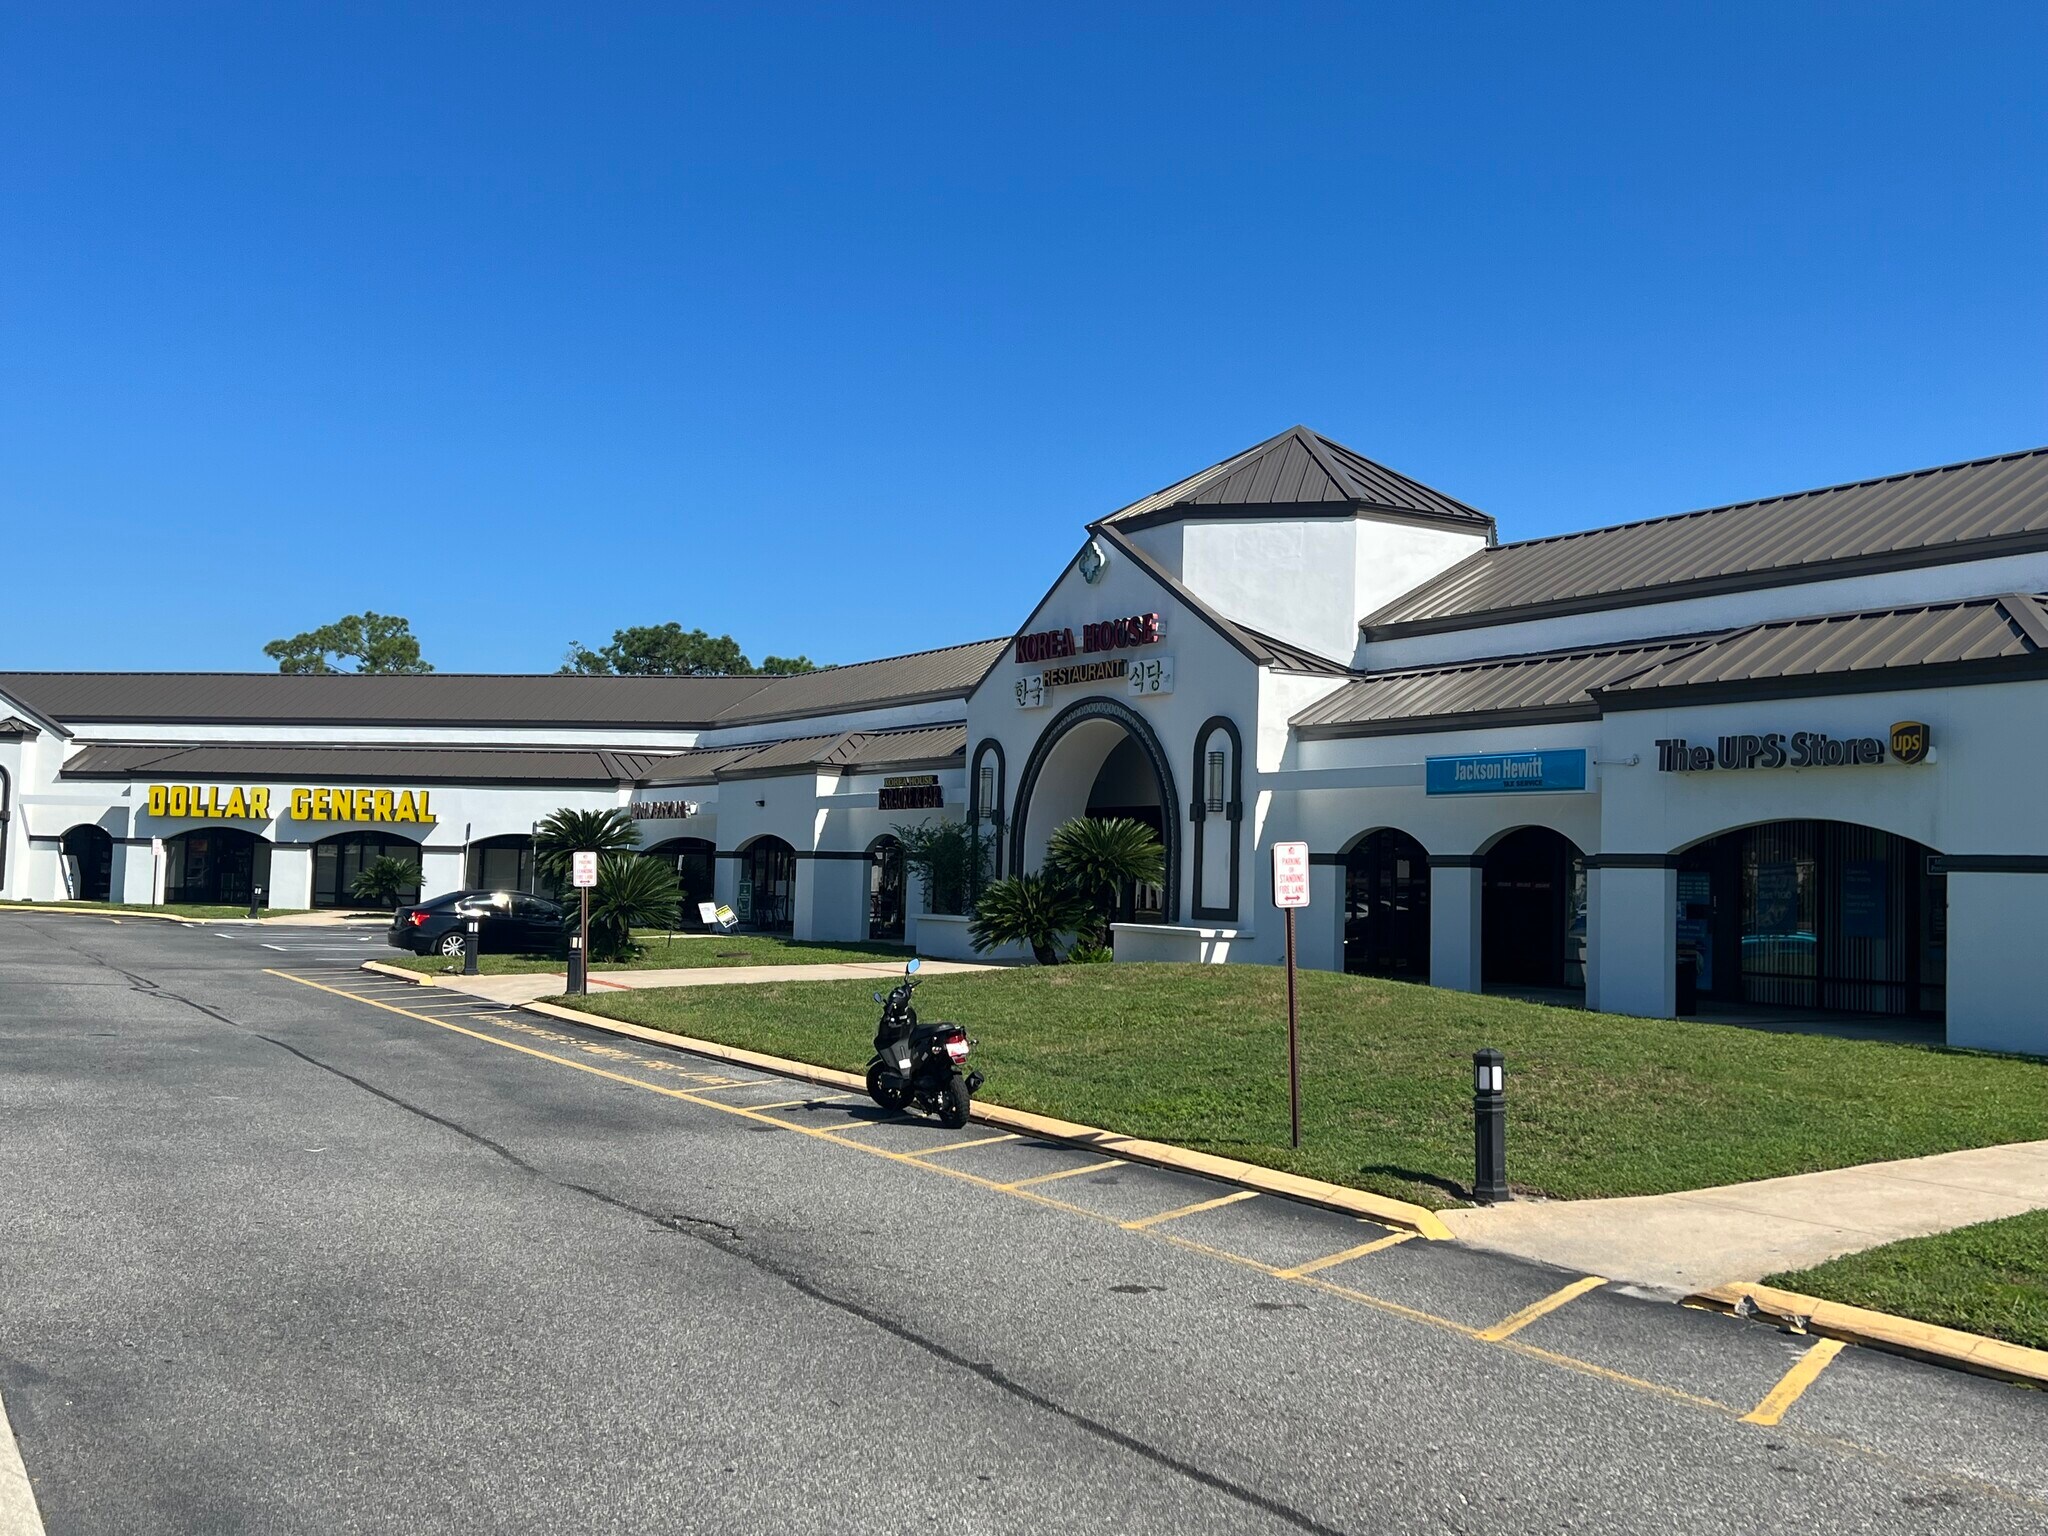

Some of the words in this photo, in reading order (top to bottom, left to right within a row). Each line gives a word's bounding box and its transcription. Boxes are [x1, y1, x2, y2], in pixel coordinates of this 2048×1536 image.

[1015, 628, 1076, 663] KOREA
[1083, 613, 1160, 653] HOUSE
[1043, 660, 1124, 687] RESTAURANT
[1129, 660, 1163, 693] 식당
[1015, 677, 1043, 707] 한국
[1655, 739, 1714, 772] The
[1717, 733, 1786, 770] UPS
[1790, 732, 1884, 767] Store
[1893, 734, 1920, 758] ups
[885, 777, 908, 787] KOREA
[908, 775, 934, 786] HOUSE
[1454, 760, 1501, 781] Jackson
[1502, 757, 1543, 779] Hewitt
[1503, 780, 1515, 788] TAX
[1516, 779, 1543, 788] SERVICE
[148, 784, 270, 820] DOLLAR
[290, 787, 436, 824] GENERAL
[1281, 857, 1301, 866] PARKING
[1279, 873, 1305, 884] STANDING
[1291, 884, 1305, 894] LANE
